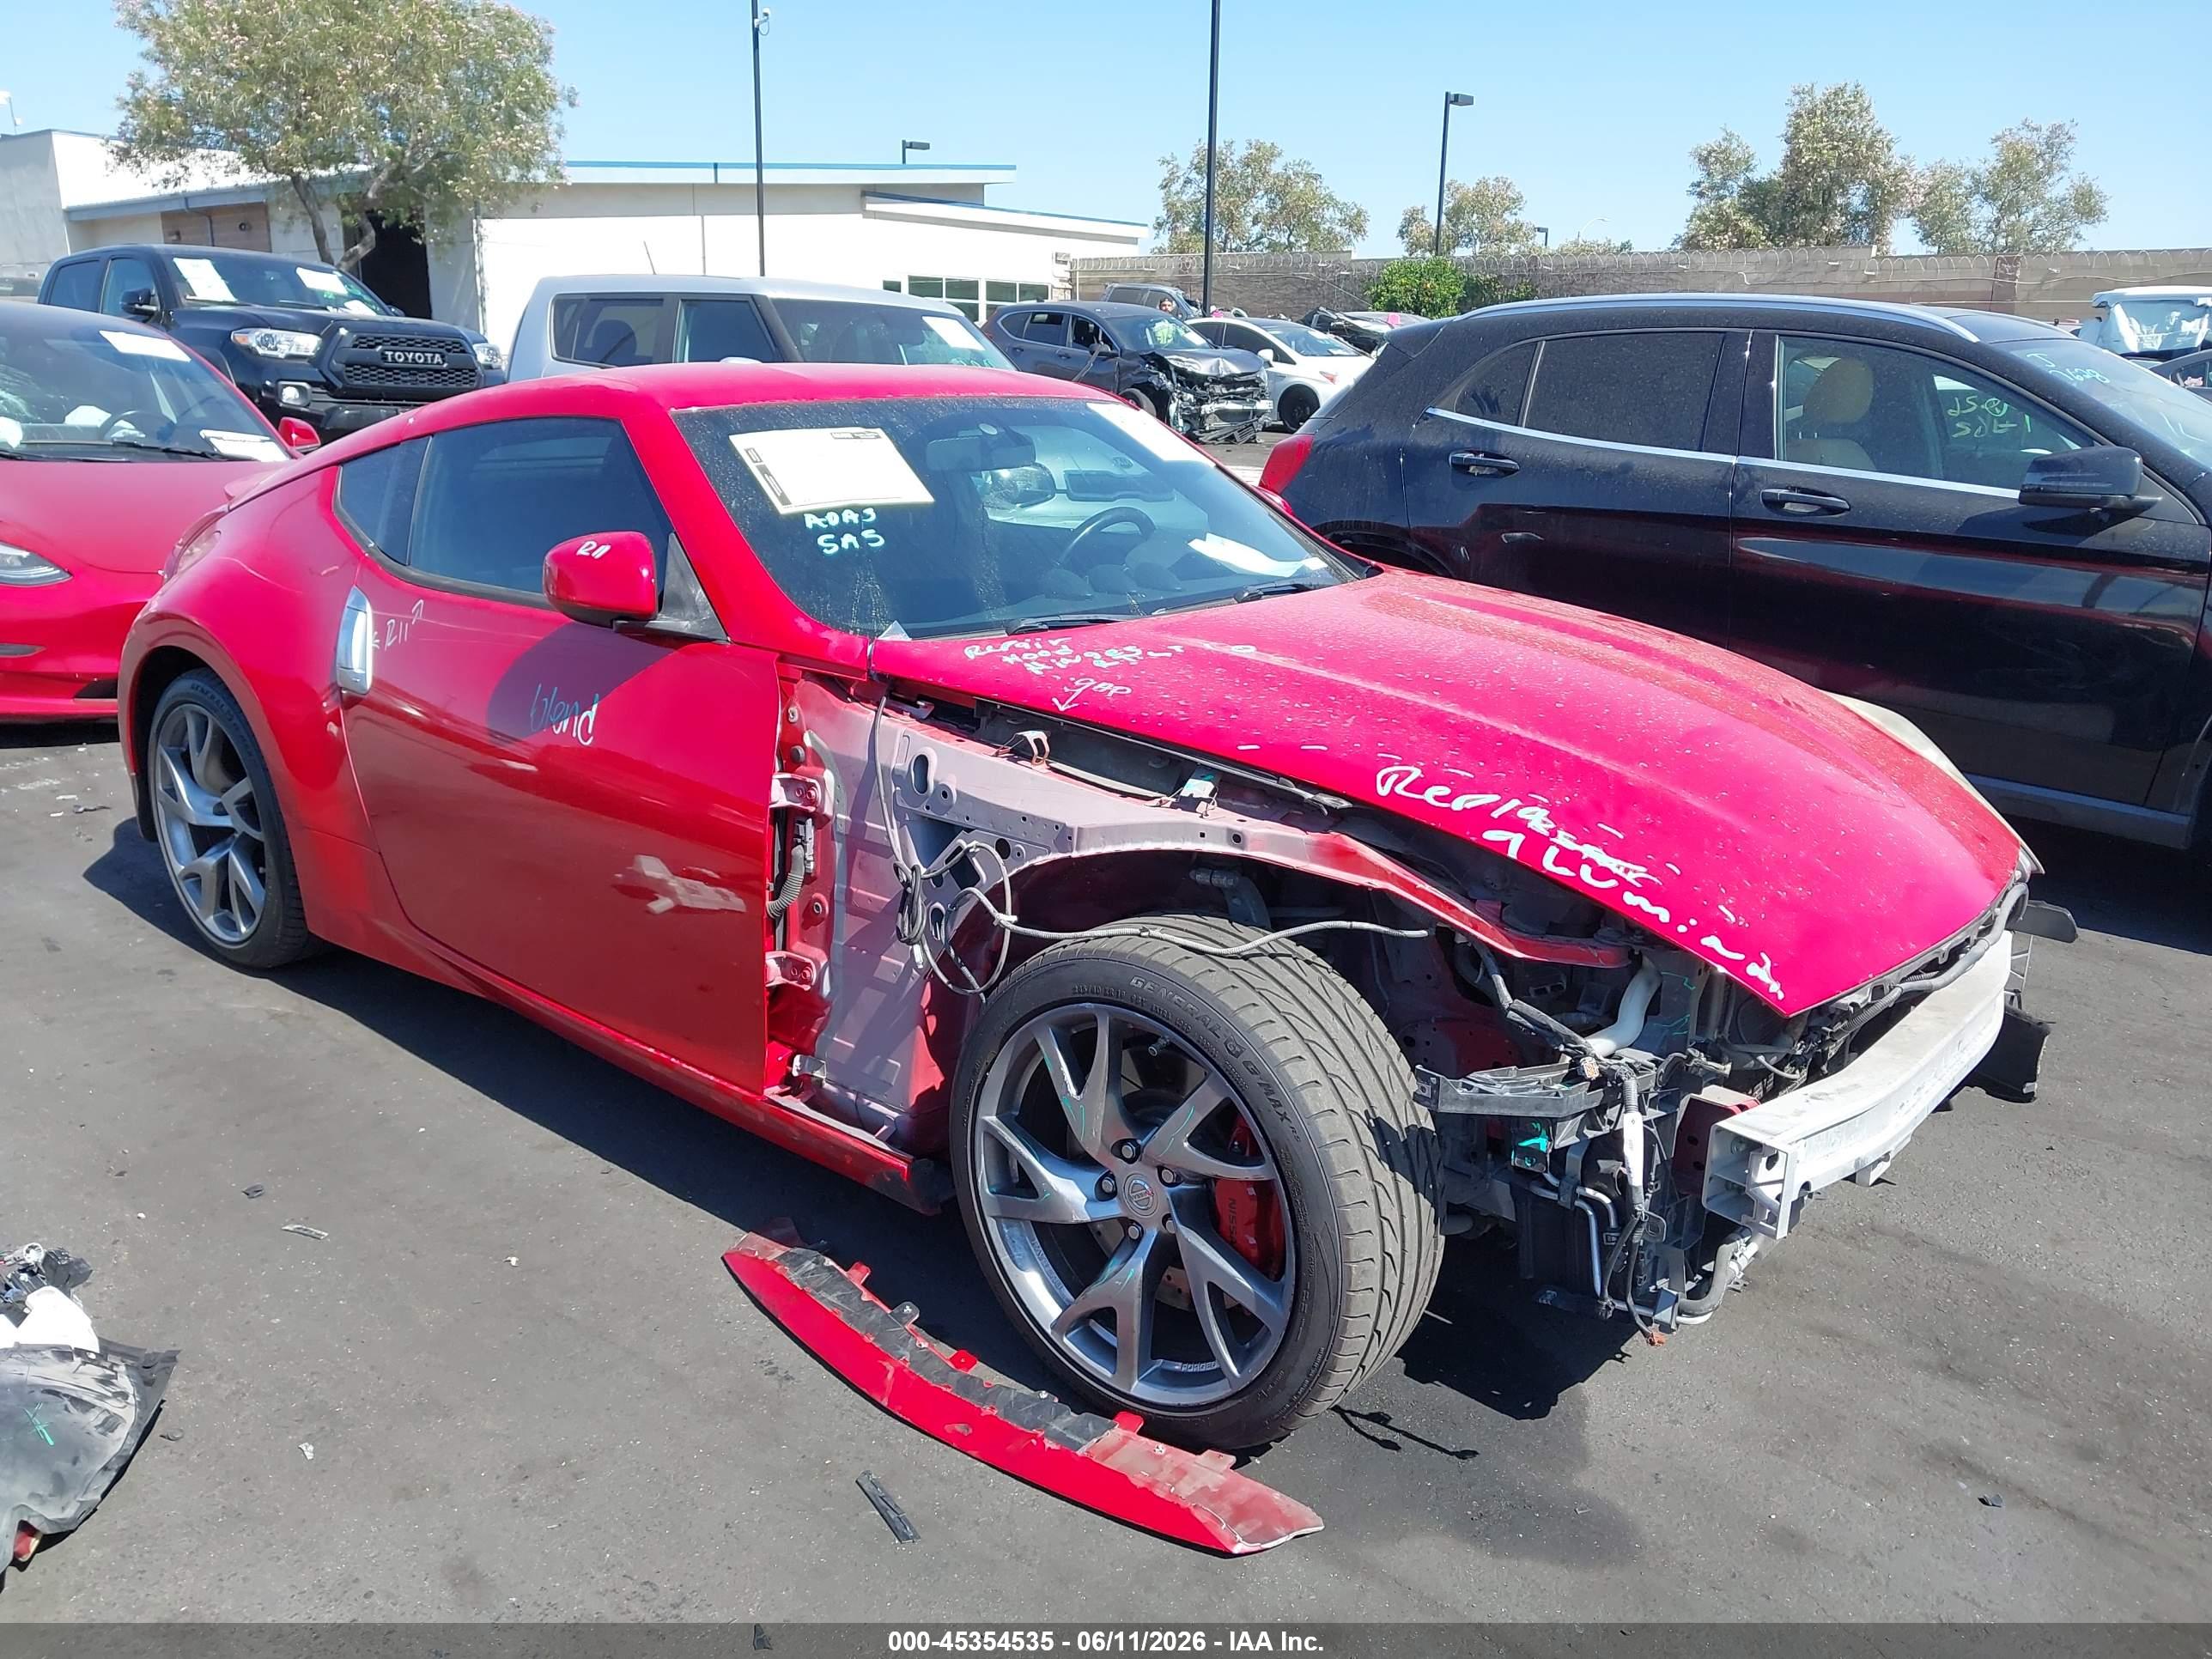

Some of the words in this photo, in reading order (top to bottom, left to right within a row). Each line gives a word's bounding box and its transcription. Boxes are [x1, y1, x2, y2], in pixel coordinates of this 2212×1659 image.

[384, 350, 444, 365] TOYOTA
[530, 683, 599, 746] blend
[1129, 975, 1221, 1039] GENERAL
